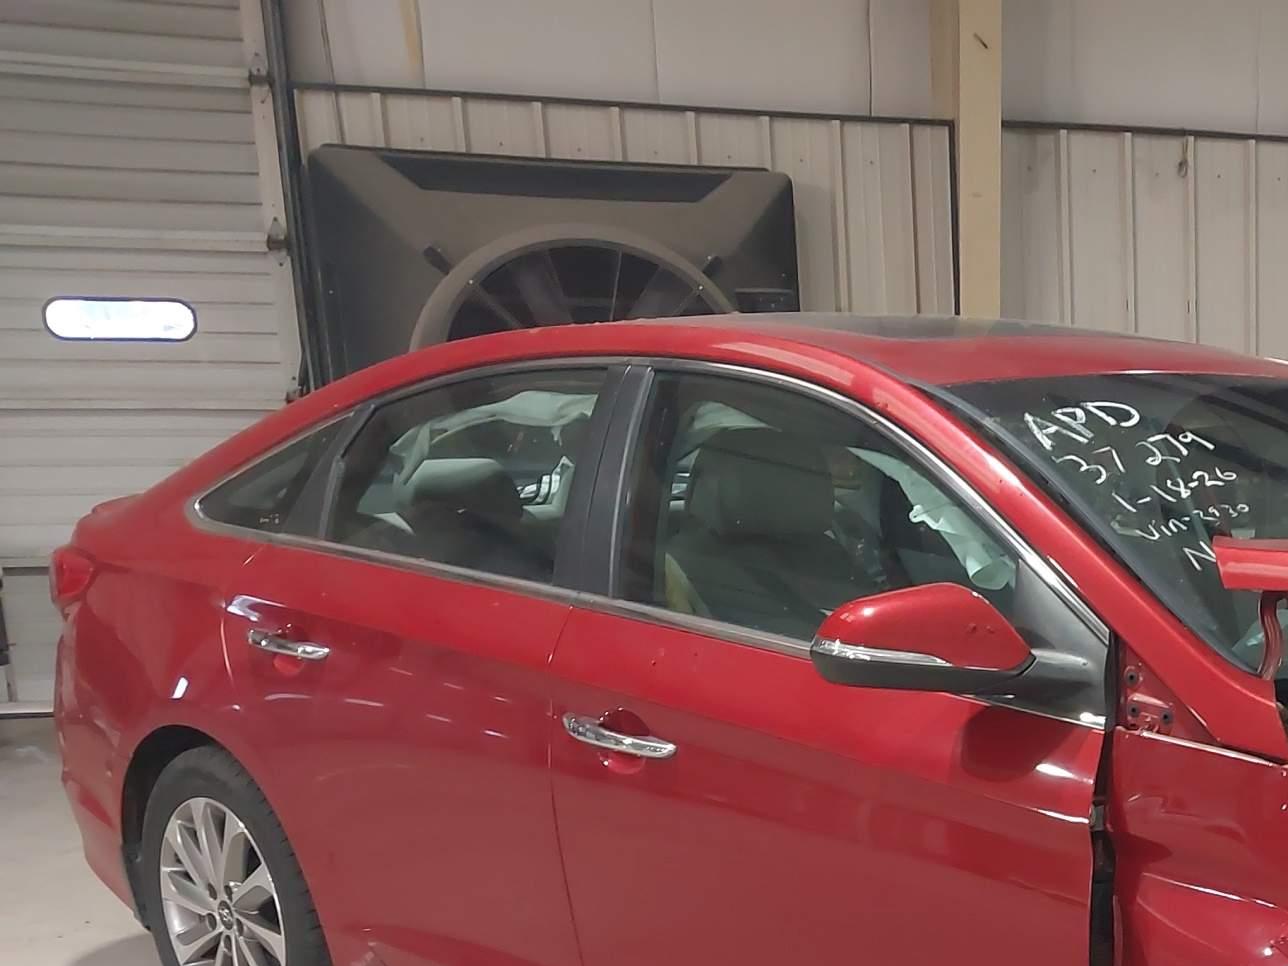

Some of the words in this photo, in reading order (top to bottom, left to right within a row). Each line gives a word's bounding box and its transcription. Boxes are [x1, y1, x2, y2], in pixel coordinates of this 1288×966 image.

[1023, 401, 1140, 451] APD
[1052, 446, 1127, 485] 37
[1136, 431, 1215, 466] 279
[1111, 466, 1237, 513] 1-18-26
